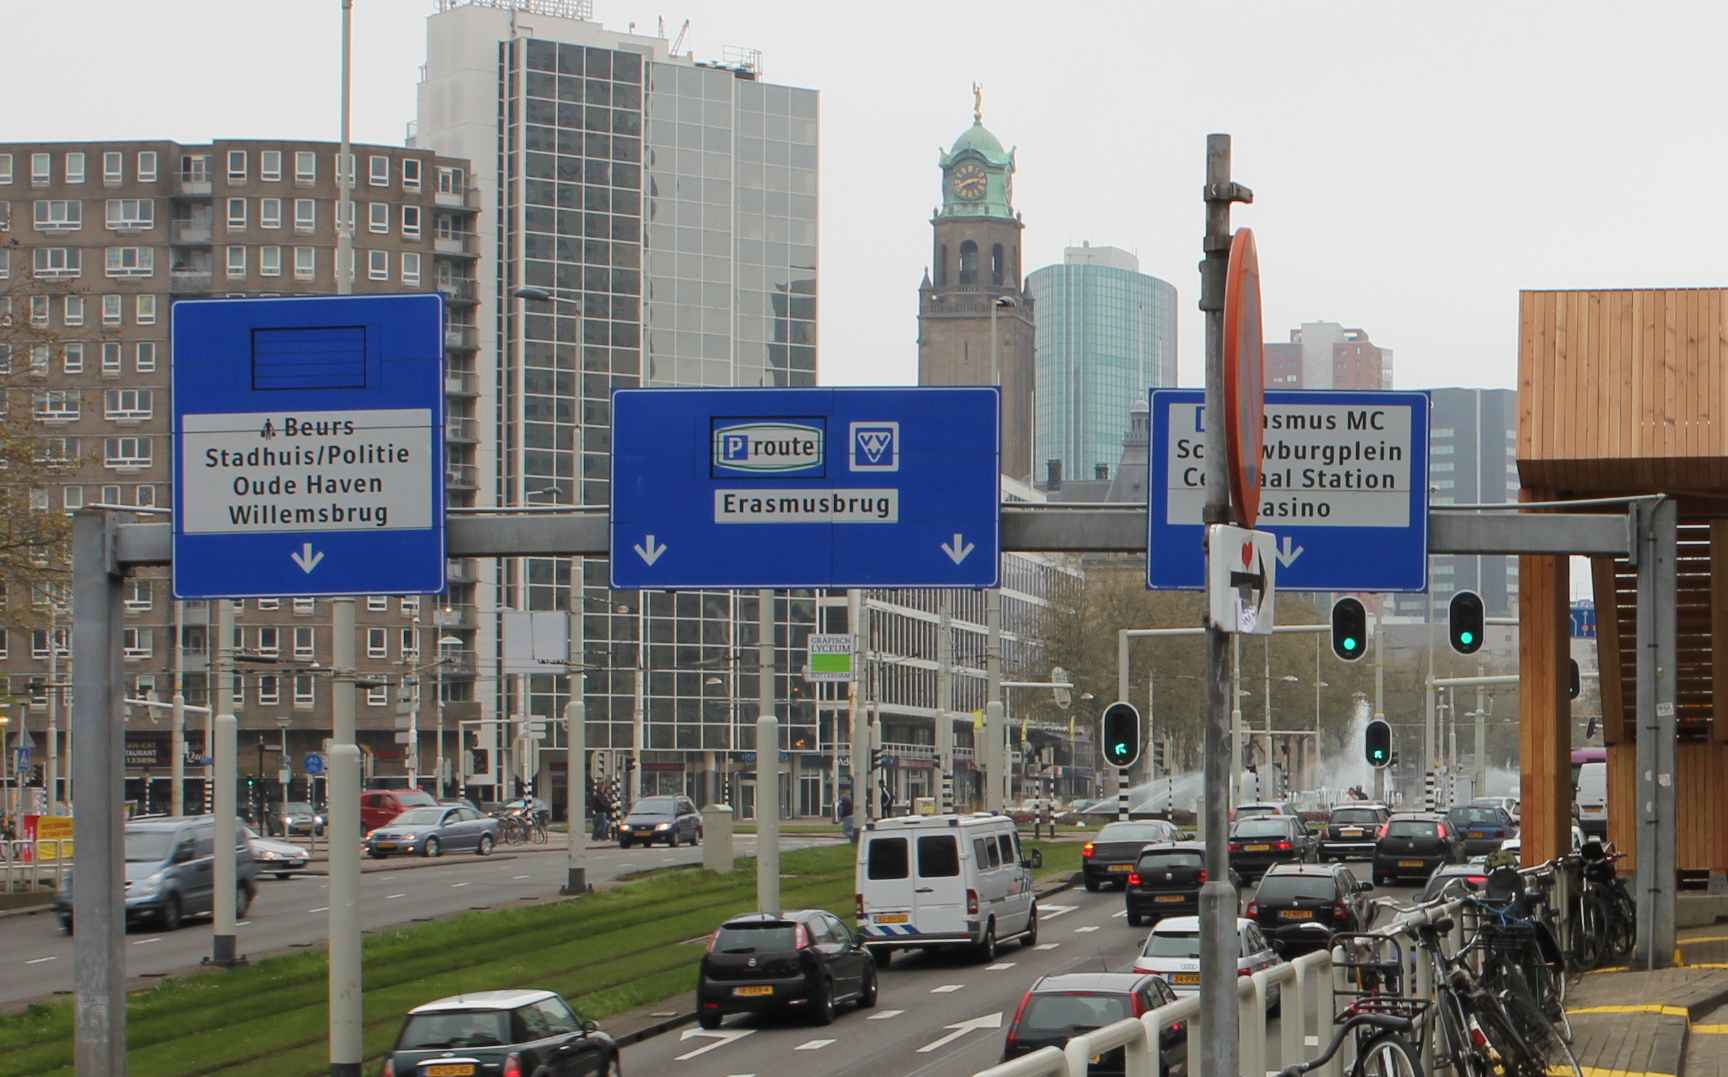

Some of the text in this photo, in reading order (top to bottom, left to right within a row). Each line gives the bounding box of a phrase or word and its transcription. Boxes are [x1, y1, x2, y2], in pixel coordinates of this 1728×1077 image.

[284, 417, 355, 437] Beurs
[1347, 410, 1385, 431] MC
[205, 444, 410, 468] Stadhuis/Politie
[728, 436, 743, 459] P
[754, 437, 815, 457] route
[1177, 439, 1402, 466] Scwburgplein
[233, 475, 383, 496] Oude Haven
[1302, 468, 1395, 490] Station
[228, 503, 389, 527] Willemsbrug
[723, 493, 890, 518] Erasmusbrug
[1257, 497, 1331, 518] asino
[811, 644, 851, 653] LYCEUM
